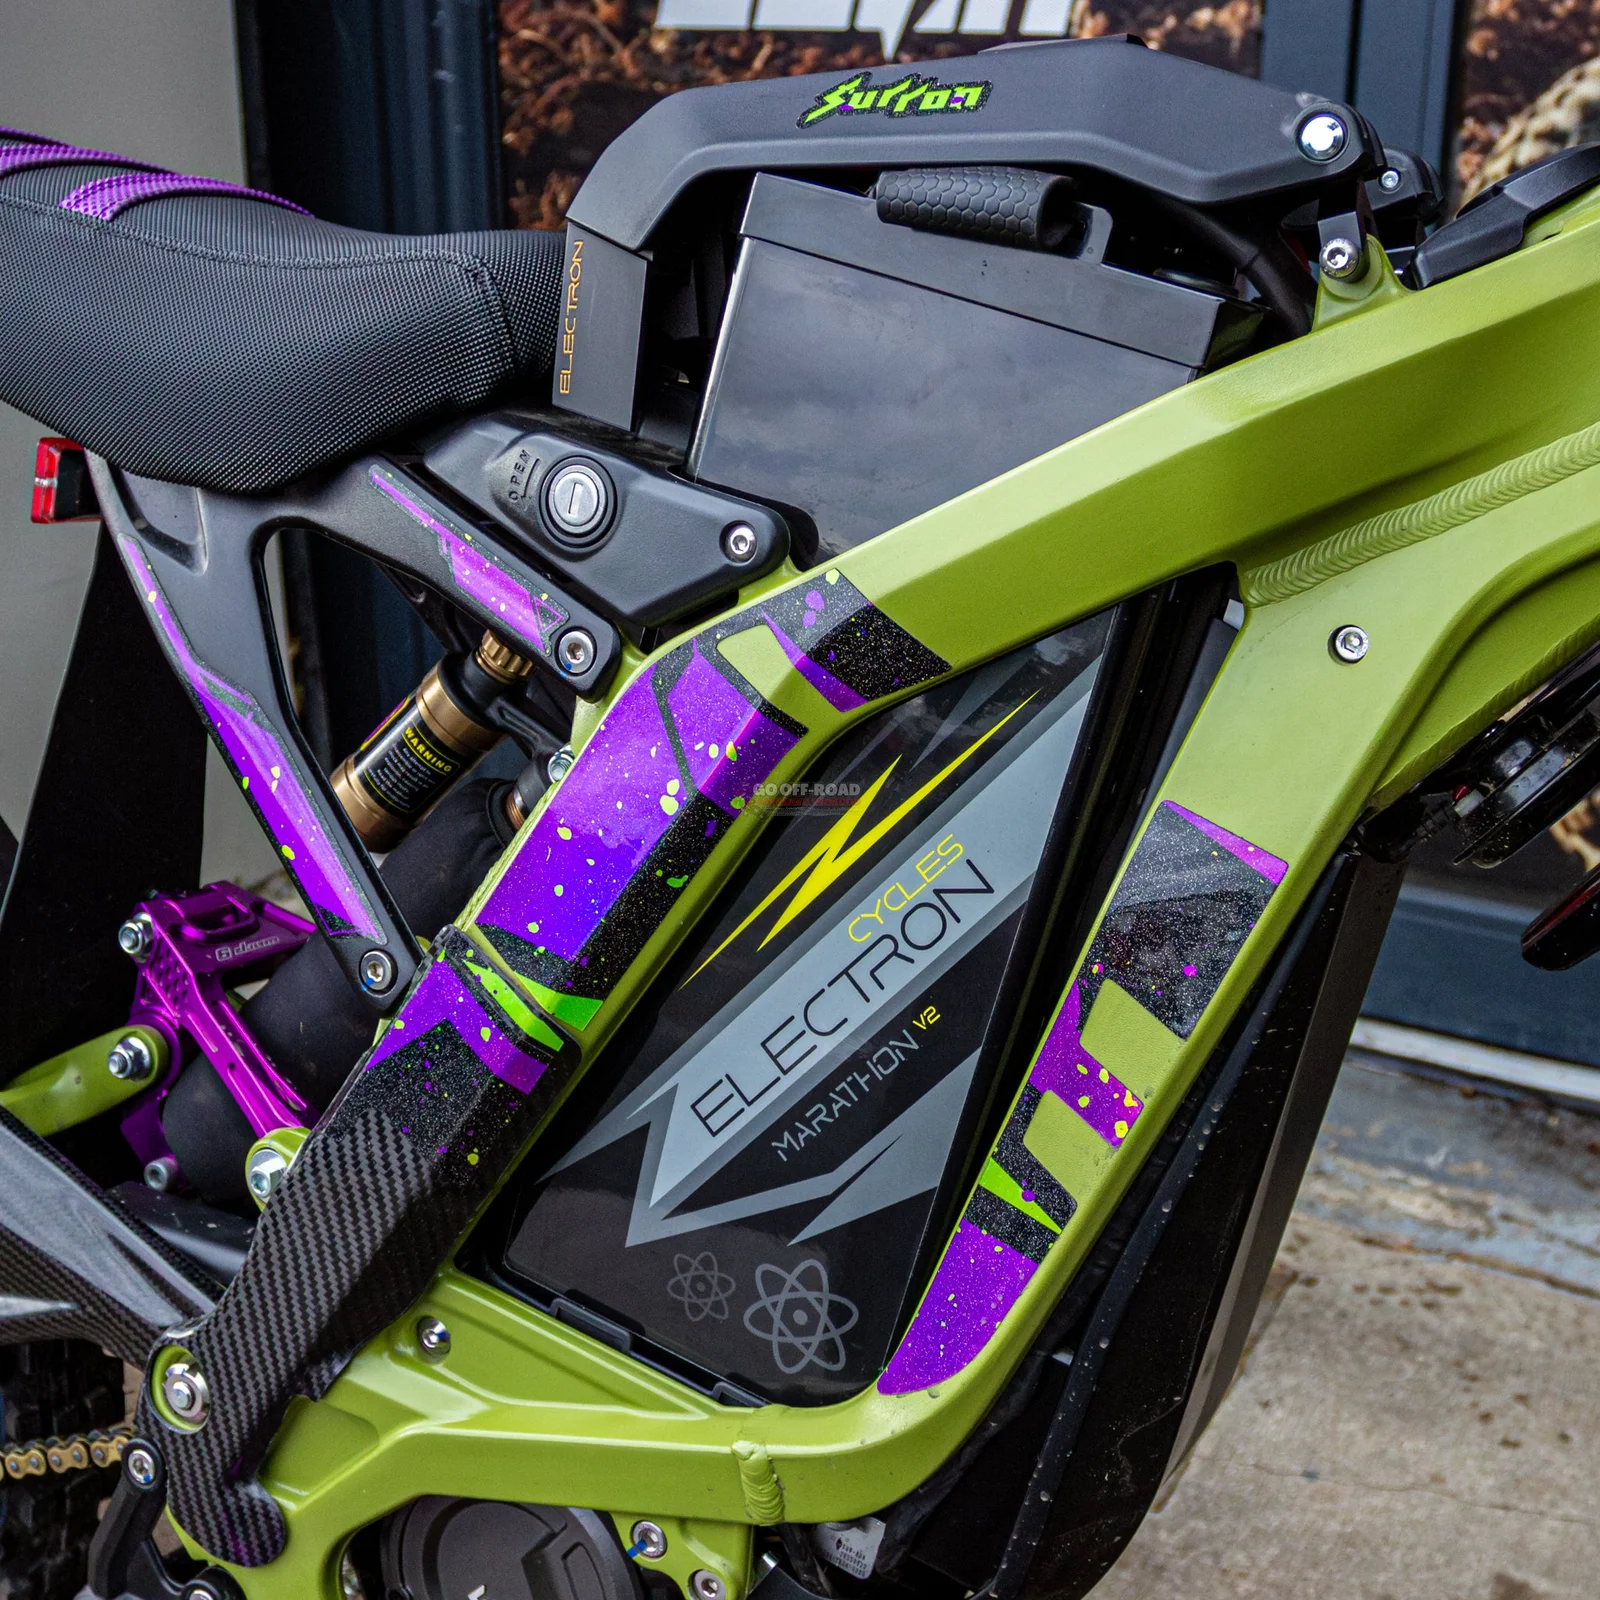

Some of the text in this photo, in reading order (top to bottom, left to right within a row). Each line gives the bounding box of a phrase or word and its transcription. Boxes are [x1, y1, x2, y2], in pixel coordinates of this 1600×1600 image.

[800, 74, 988, 127] Surron
[559, 240, 584, 394] ELECTRON
[508, 449, 531, 503] OPEN
[404, 726, 453, 774] WARNING
[848, 833, 964, 943] CYCLES
[690, 858, 995, 1138] ELECTRON
[770, 1005, 942, 1162] MARATHON V2
